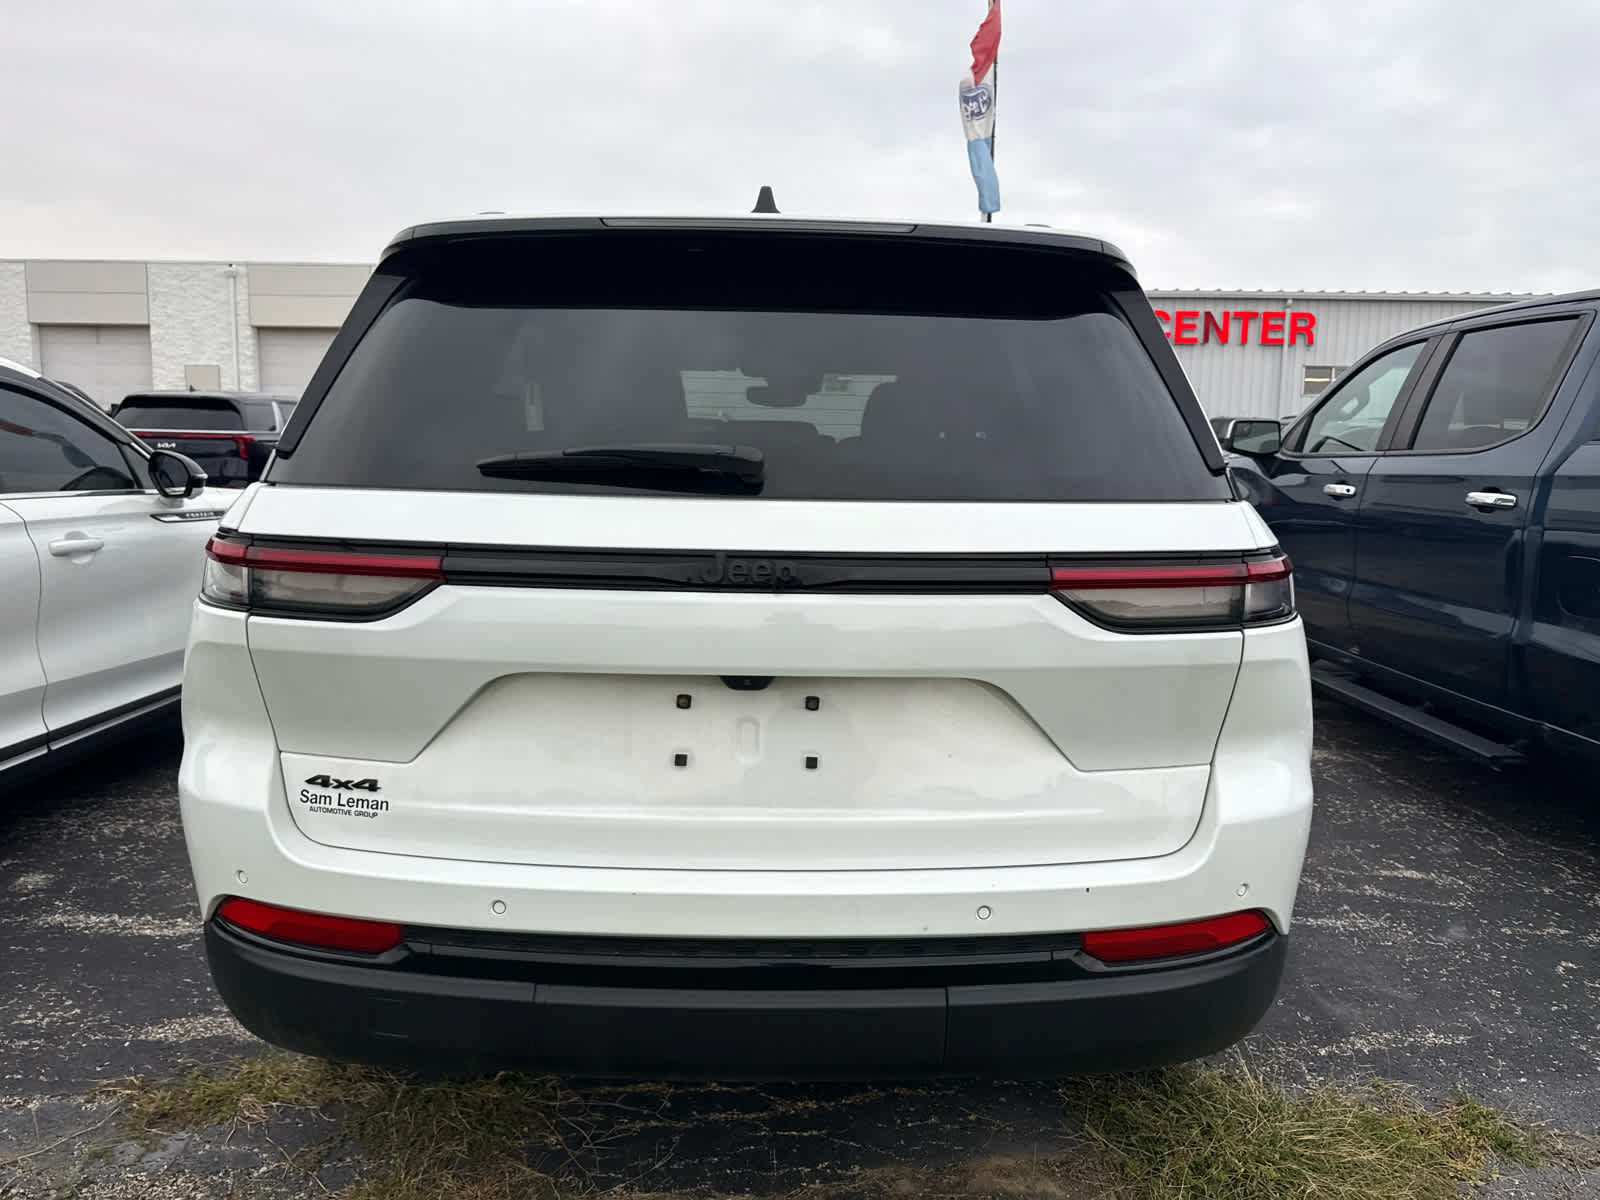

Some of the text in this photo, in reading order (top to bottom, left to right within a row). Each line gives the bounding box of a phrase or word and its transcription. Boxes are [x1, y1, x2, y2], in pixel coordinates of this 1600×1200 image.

[702, 552, 796, 589] Jeep
[304, 774, 382, 792] 4x4
[300, 789, 389, 811] Sam Leman
[309, 806, 378, 818] AUTOMOTIVE GROUP
